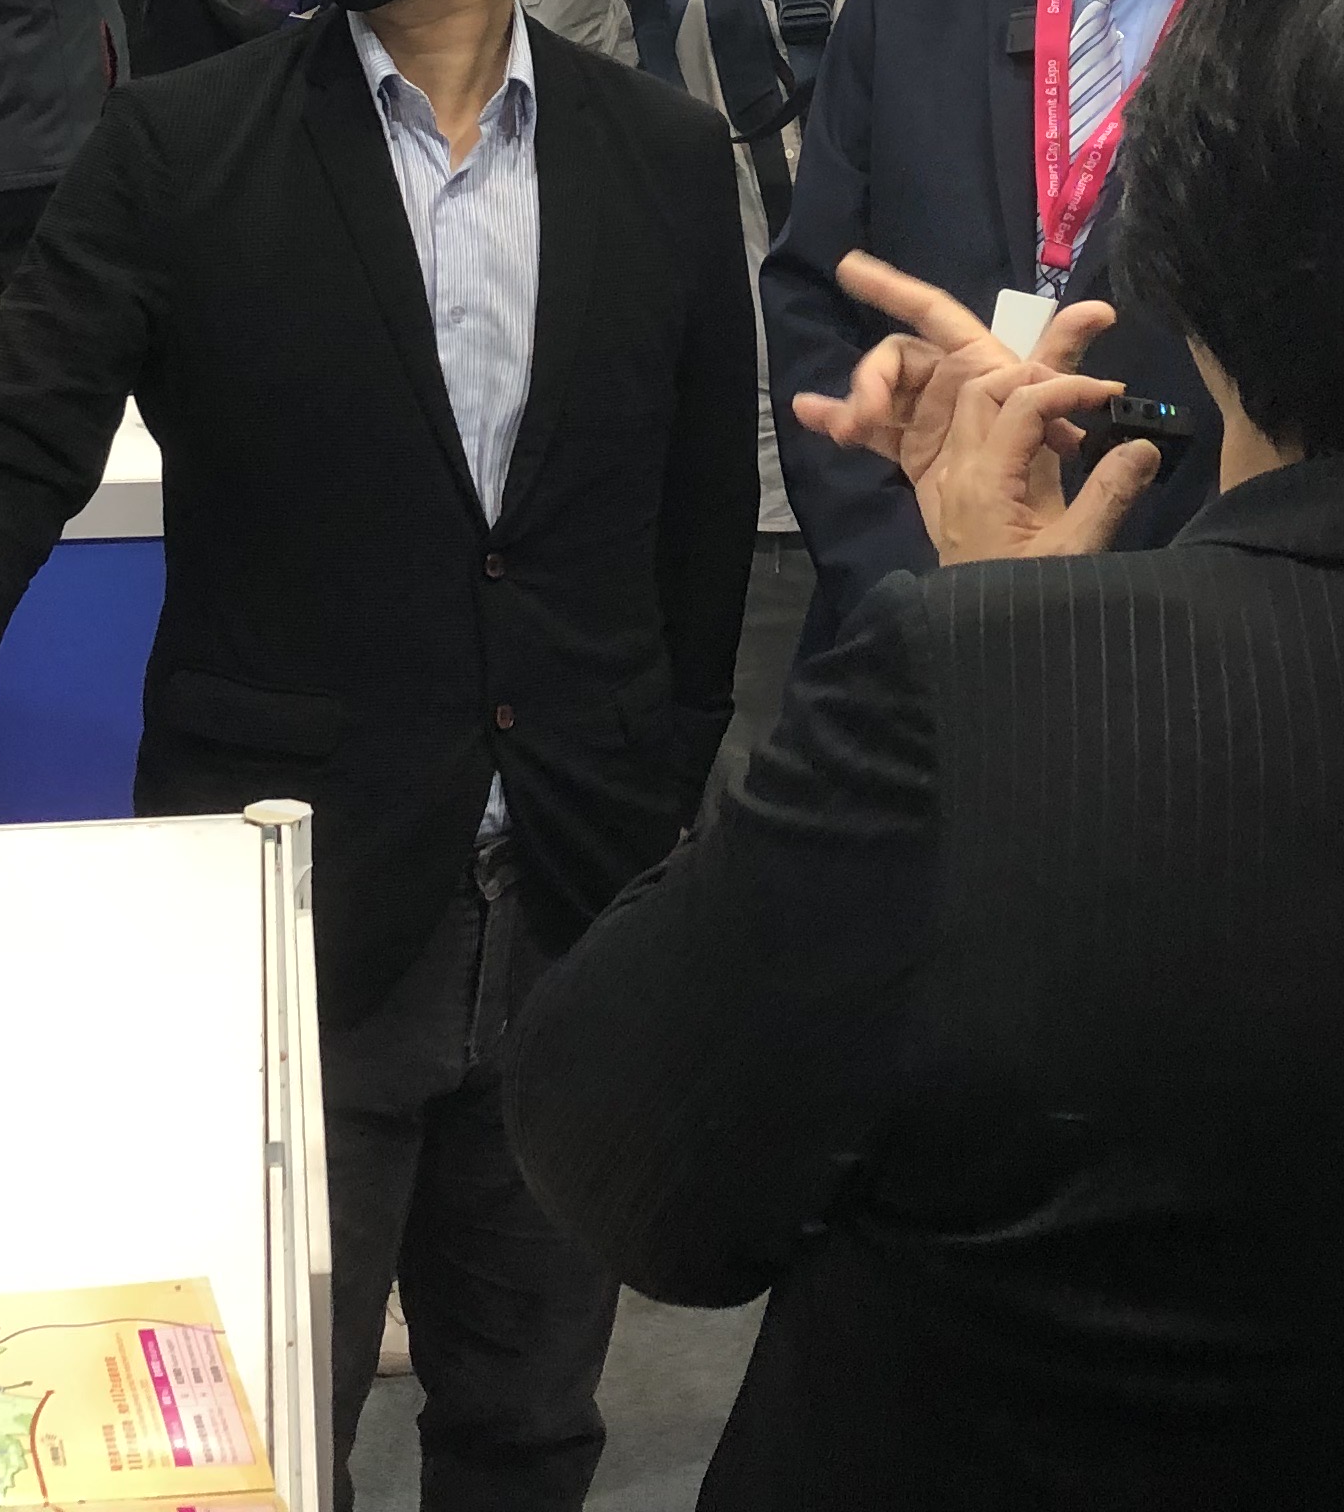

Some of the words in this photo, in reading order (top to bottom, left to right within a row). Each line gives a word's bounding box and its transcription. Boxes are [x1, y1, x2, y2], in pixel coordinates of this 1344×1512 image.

[1045, 59, 1058, 85] Expo
[1045, 87, 1057, 96] &
[1046, 99, 1058, 138] Summit
[1093, 121, 1118, 149] Smart
[1046, 141, 1060, 162] City
[1082, 152, 1101, 173] City
[1047, 163, 1059, 198] Smart
[1068, 172, 1093, 211] Summit
